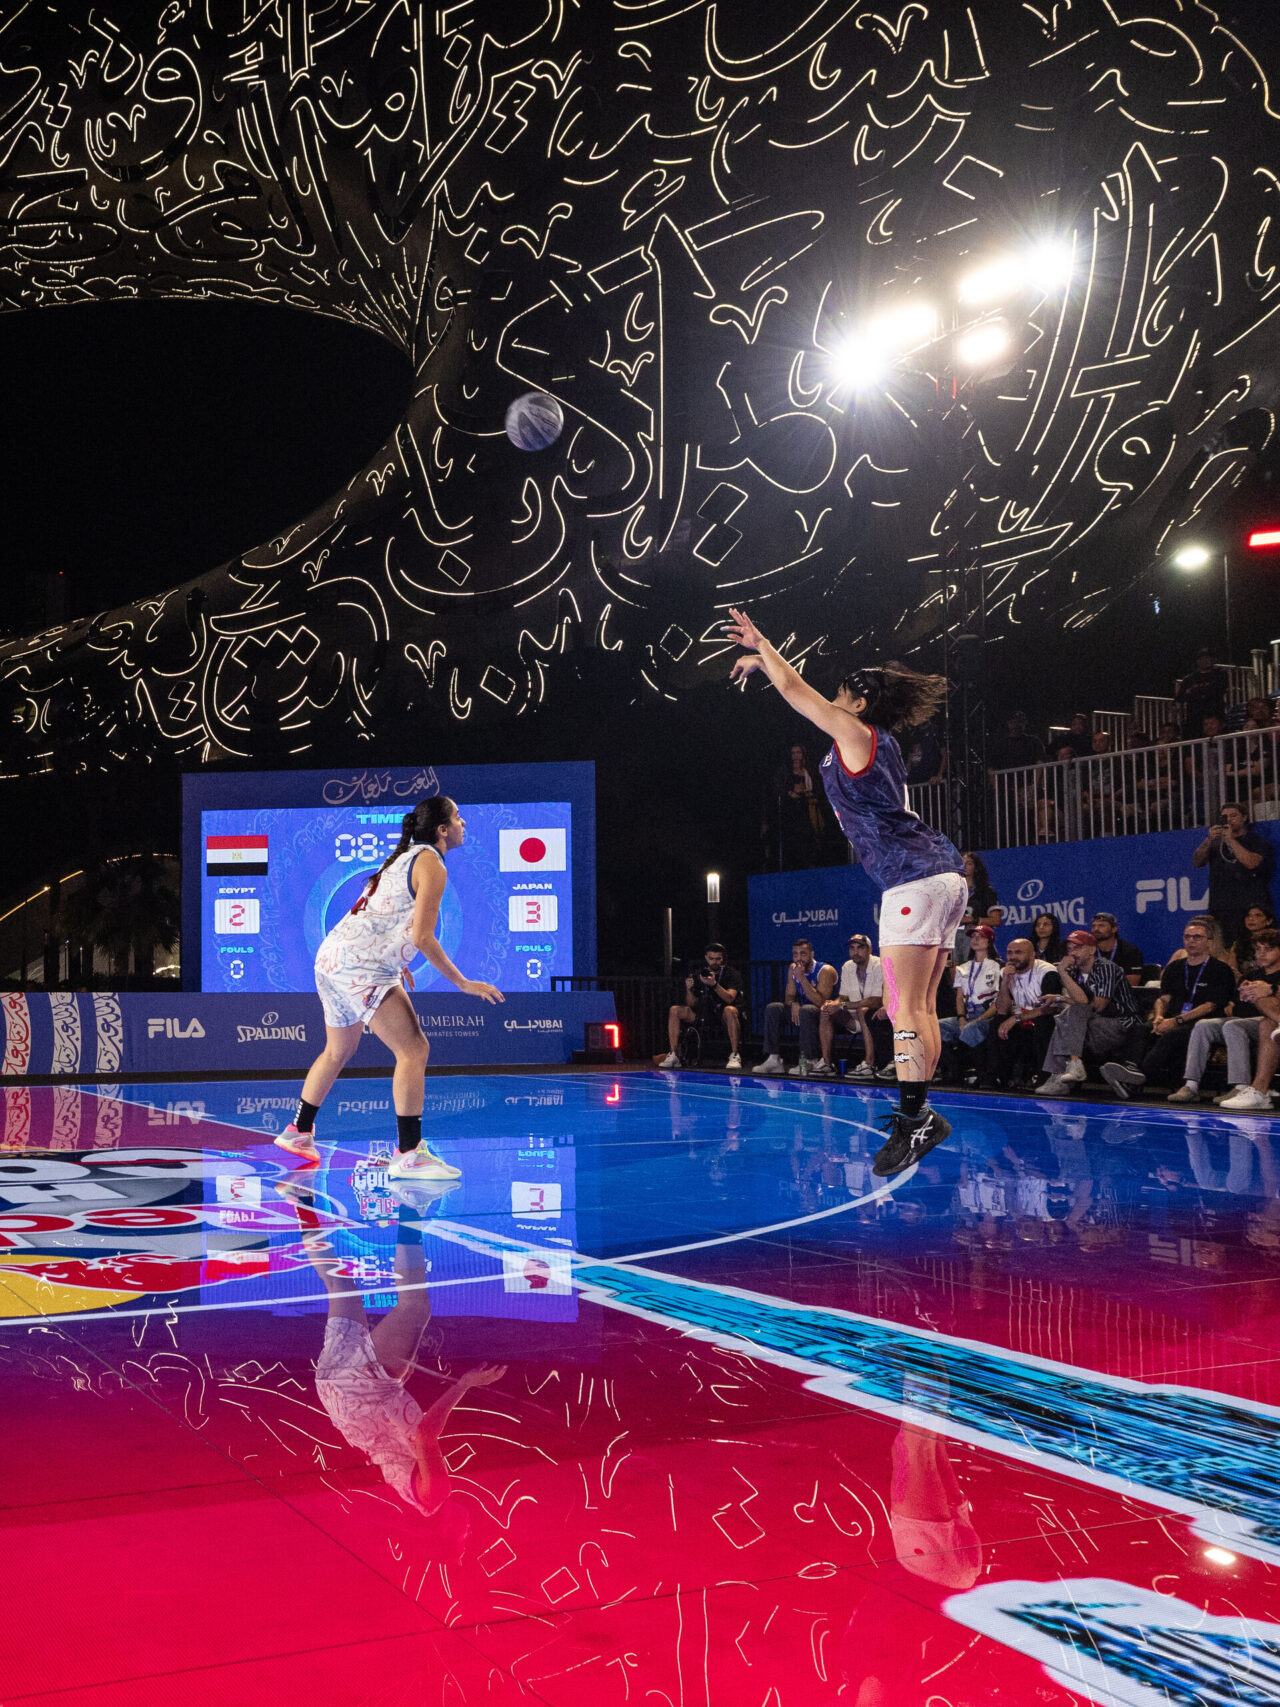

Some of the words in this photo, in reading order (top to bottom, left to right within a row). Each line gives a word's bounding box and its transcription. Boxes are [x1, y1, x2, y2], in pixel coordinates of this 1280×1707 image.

[1135, 876, 1210, 915] FIL
[229, 904, 245, 926] 2
[525, 902, 541, 923] 3
[220, 946, 255, 954] FOULS
[515, 944, 553, 952] FOULS
[147, 1017, 206, 1039] FILA
[236, 1024, 307, 1043] SPALDING
